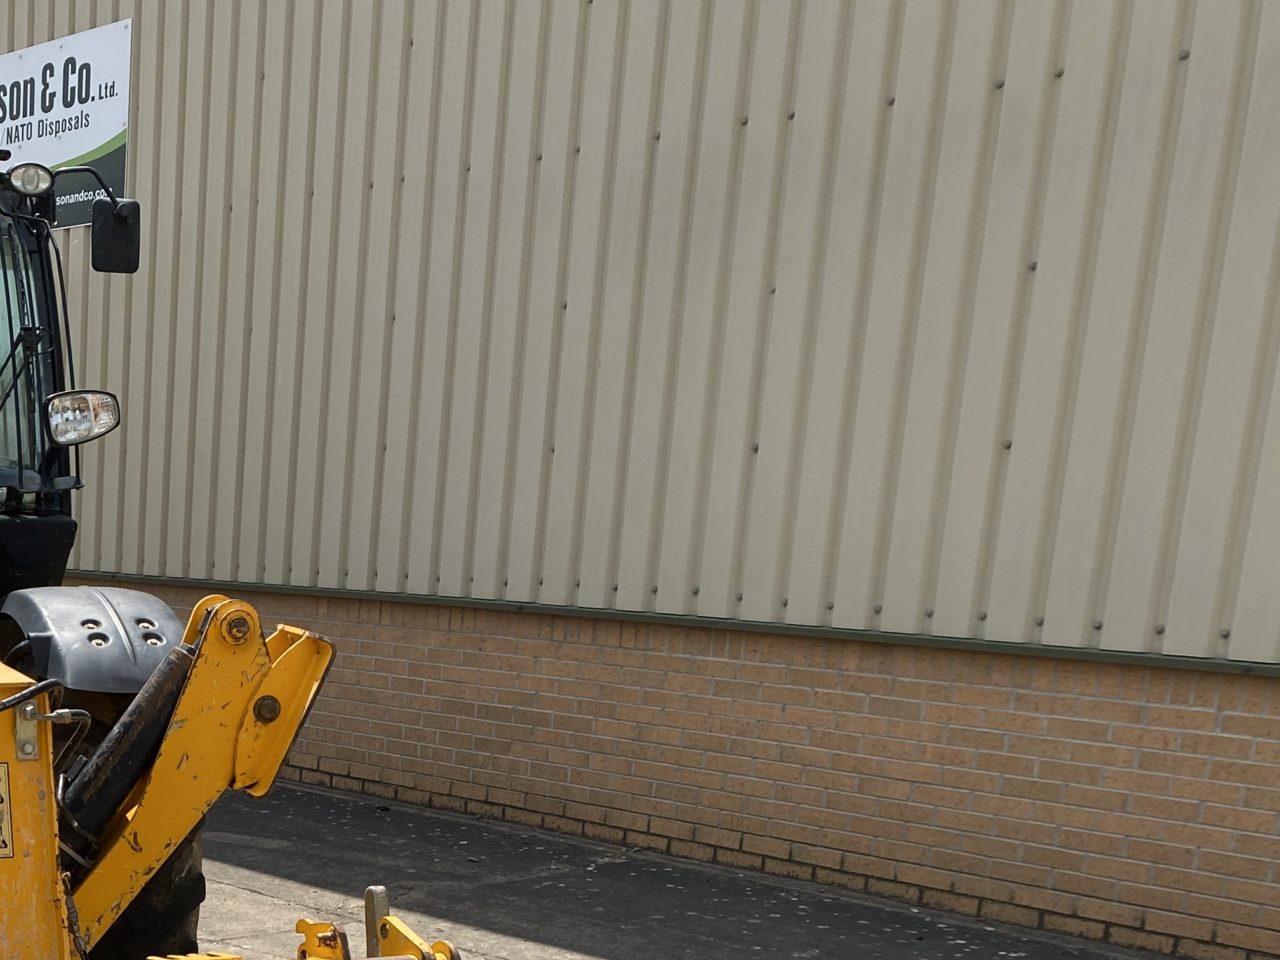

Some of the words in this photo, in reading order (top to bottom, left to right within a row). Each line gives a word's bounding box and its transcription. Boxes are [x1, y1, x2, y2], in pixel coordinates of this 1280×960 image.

[40, 62, 57, 114] &
[62, 56, 95, 109] Co.
[98, 80, 119, 101] Ltd.
[37, 110, 90, 138] Disposals
